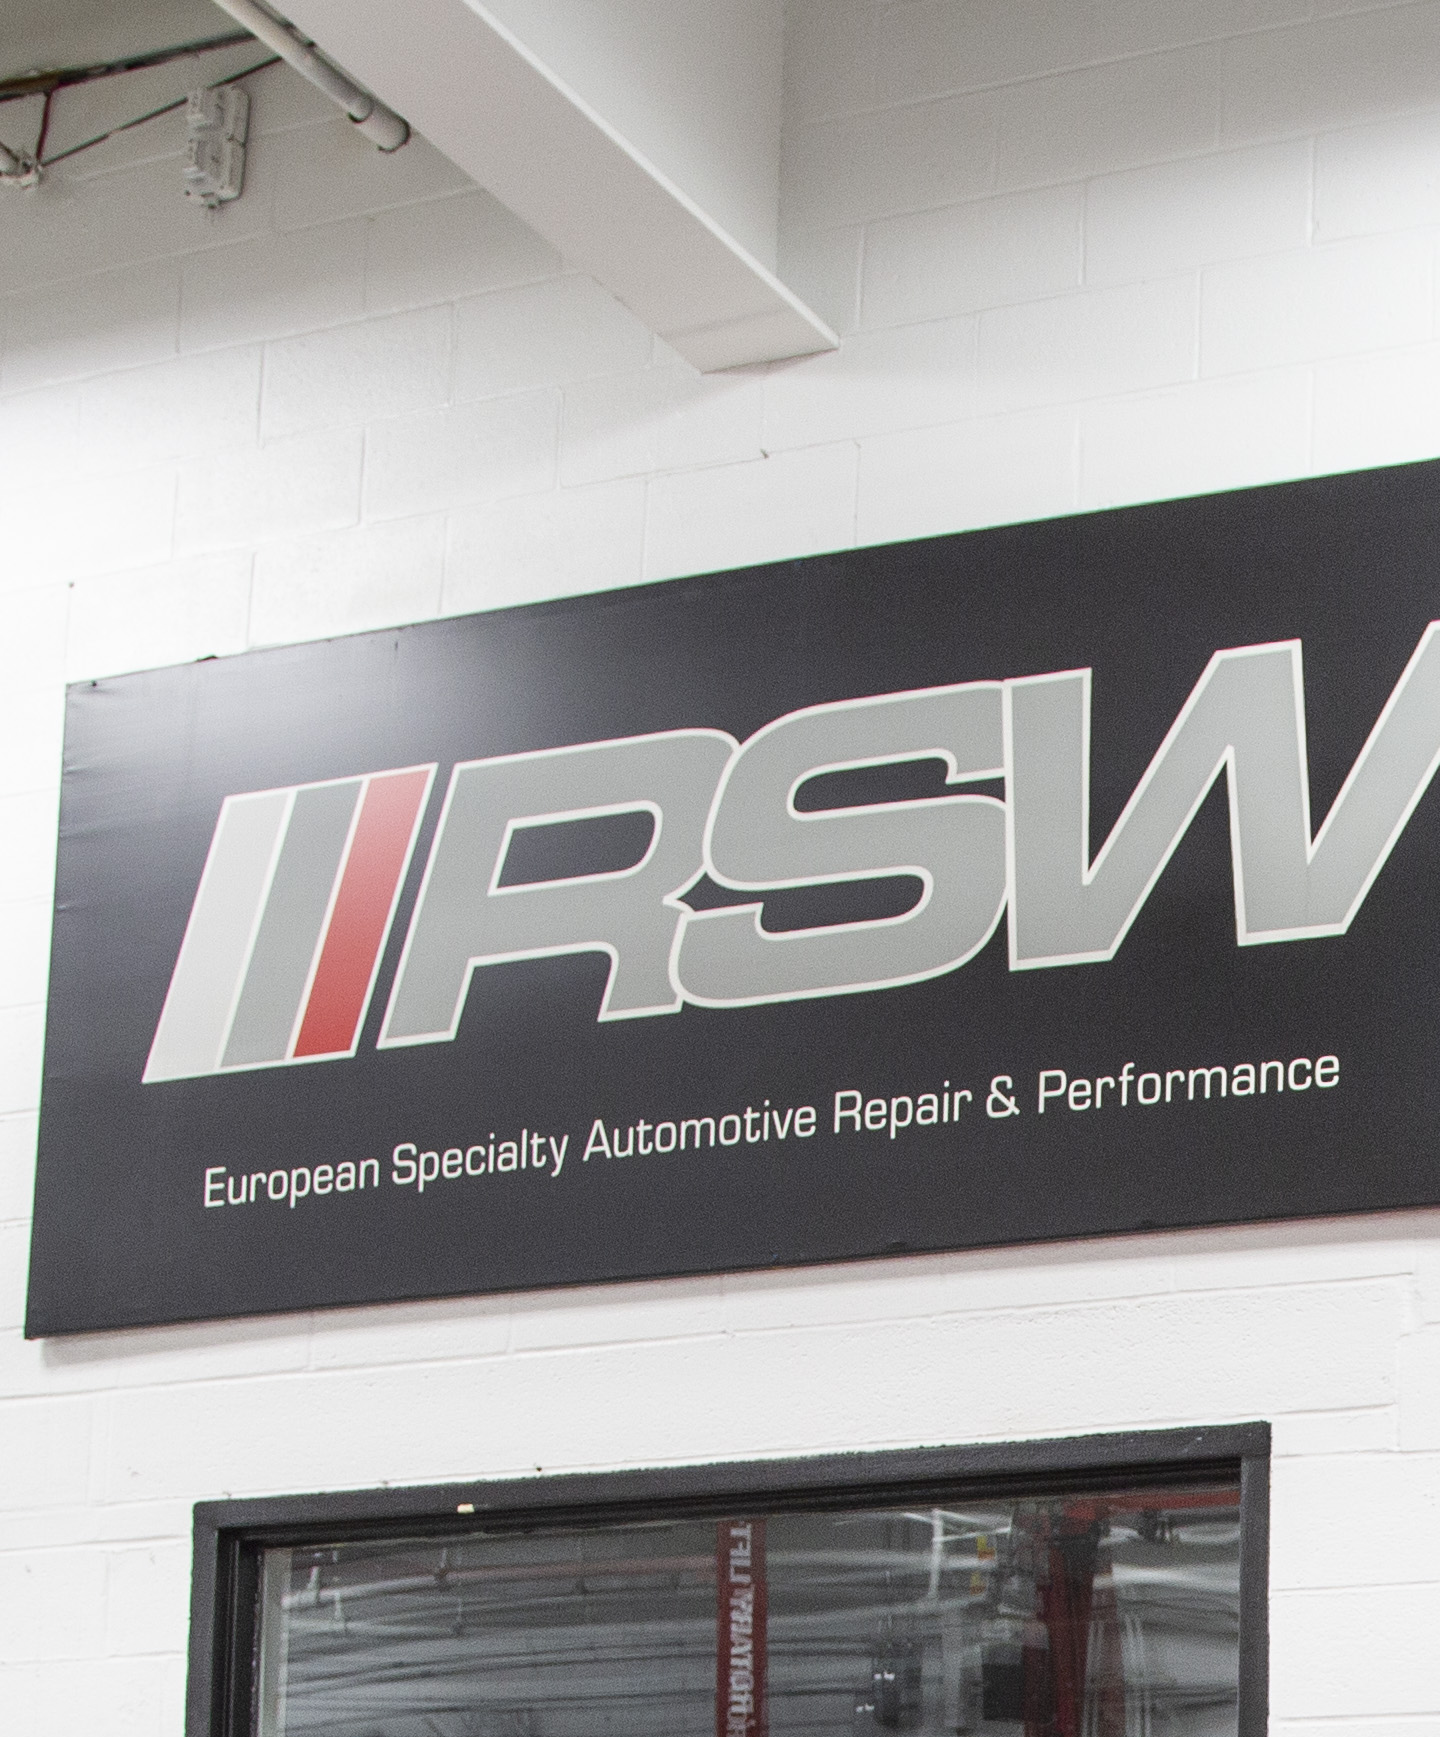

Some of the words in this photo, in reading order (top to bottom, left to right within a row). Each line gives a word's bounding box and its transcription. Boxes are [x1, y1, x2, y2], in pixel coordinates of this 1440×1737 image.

[203, 1156, 380, 1209] European
[391, 1128, 569, 1193] Specialty
[582, 1099, 817, 1162] Automotive
[833, 1080, 973, 1140] Repair
[985, 1074, 1020, 1119] &
[1037, 1053, 1341, 1115] Performance
